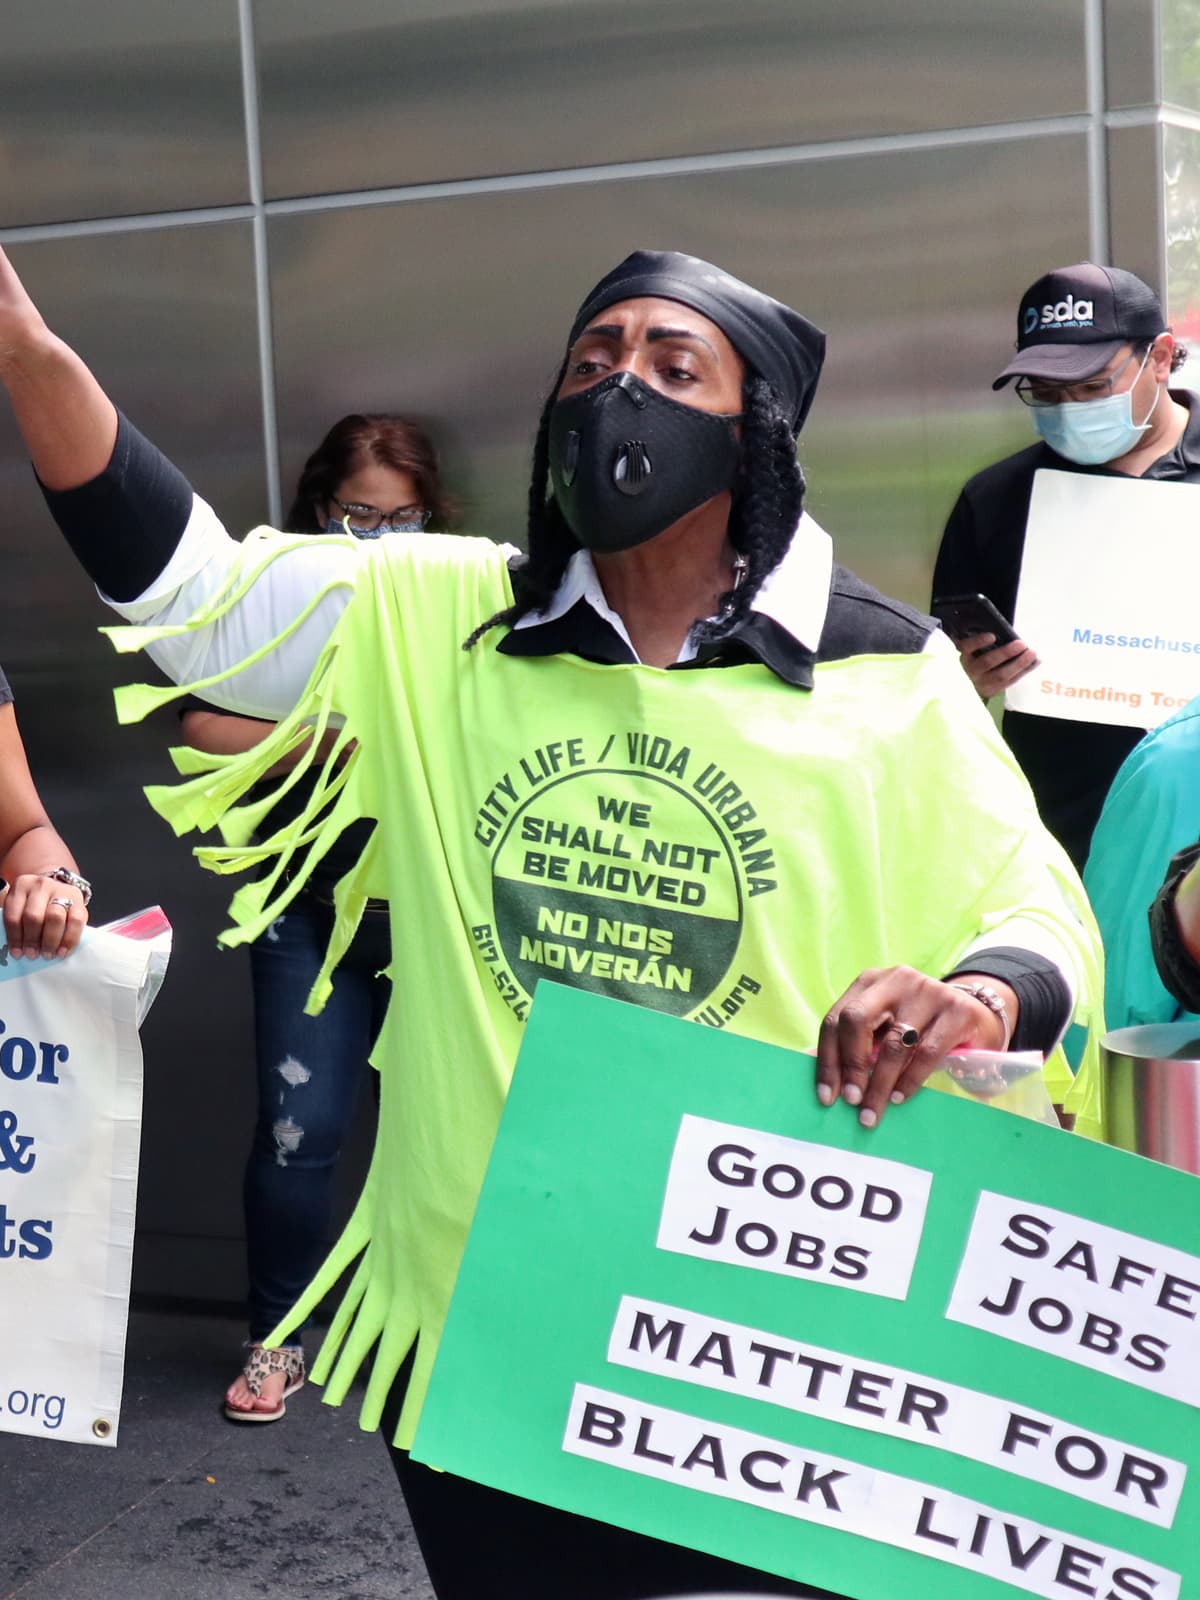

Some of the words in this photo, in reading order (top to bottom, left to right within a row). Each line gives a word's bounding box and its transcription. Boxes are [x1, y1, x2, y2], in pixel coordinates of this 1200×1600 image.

[1041, 294, 1093, 323] sda
[1040, 680, 1142, 708] Standing
[474, 773, 520, 847] CITY
[519, 737, 586, 786] LIFE
[597, 735, 615, 763] /
[626, 732, 692, 779] VIDA
[692, 762, 778, 898] URBANA
[521, 816, 632, 860] SHALL
[642, 839, 721, 874] NOT
[597, 795, 652, 828] WE
[523, 851, 570, 882] BE
[577, 861, 707, 907] MOVED
[520, 935, 692, 993] MOVERÁN
[537, 906, 589, 939] NO
[597, 918, 674, 955] NOS
[472, 924, 528, 1022] 617-524
[707, 1143, 904, 1224] GOOD
[689, 1206, 872, 1281] JOBS
[1000, 1213, 1200, 1322] SAFE
[979, 1277, 1171, 1374] JOBS
[627, 1310, 950, 1435] MATTER
[1000, 1412, 1170, 1508] FOR
[578, 1401, 851, 1512] BLACK
[914, 1496, 1161, 1600] LIVES
